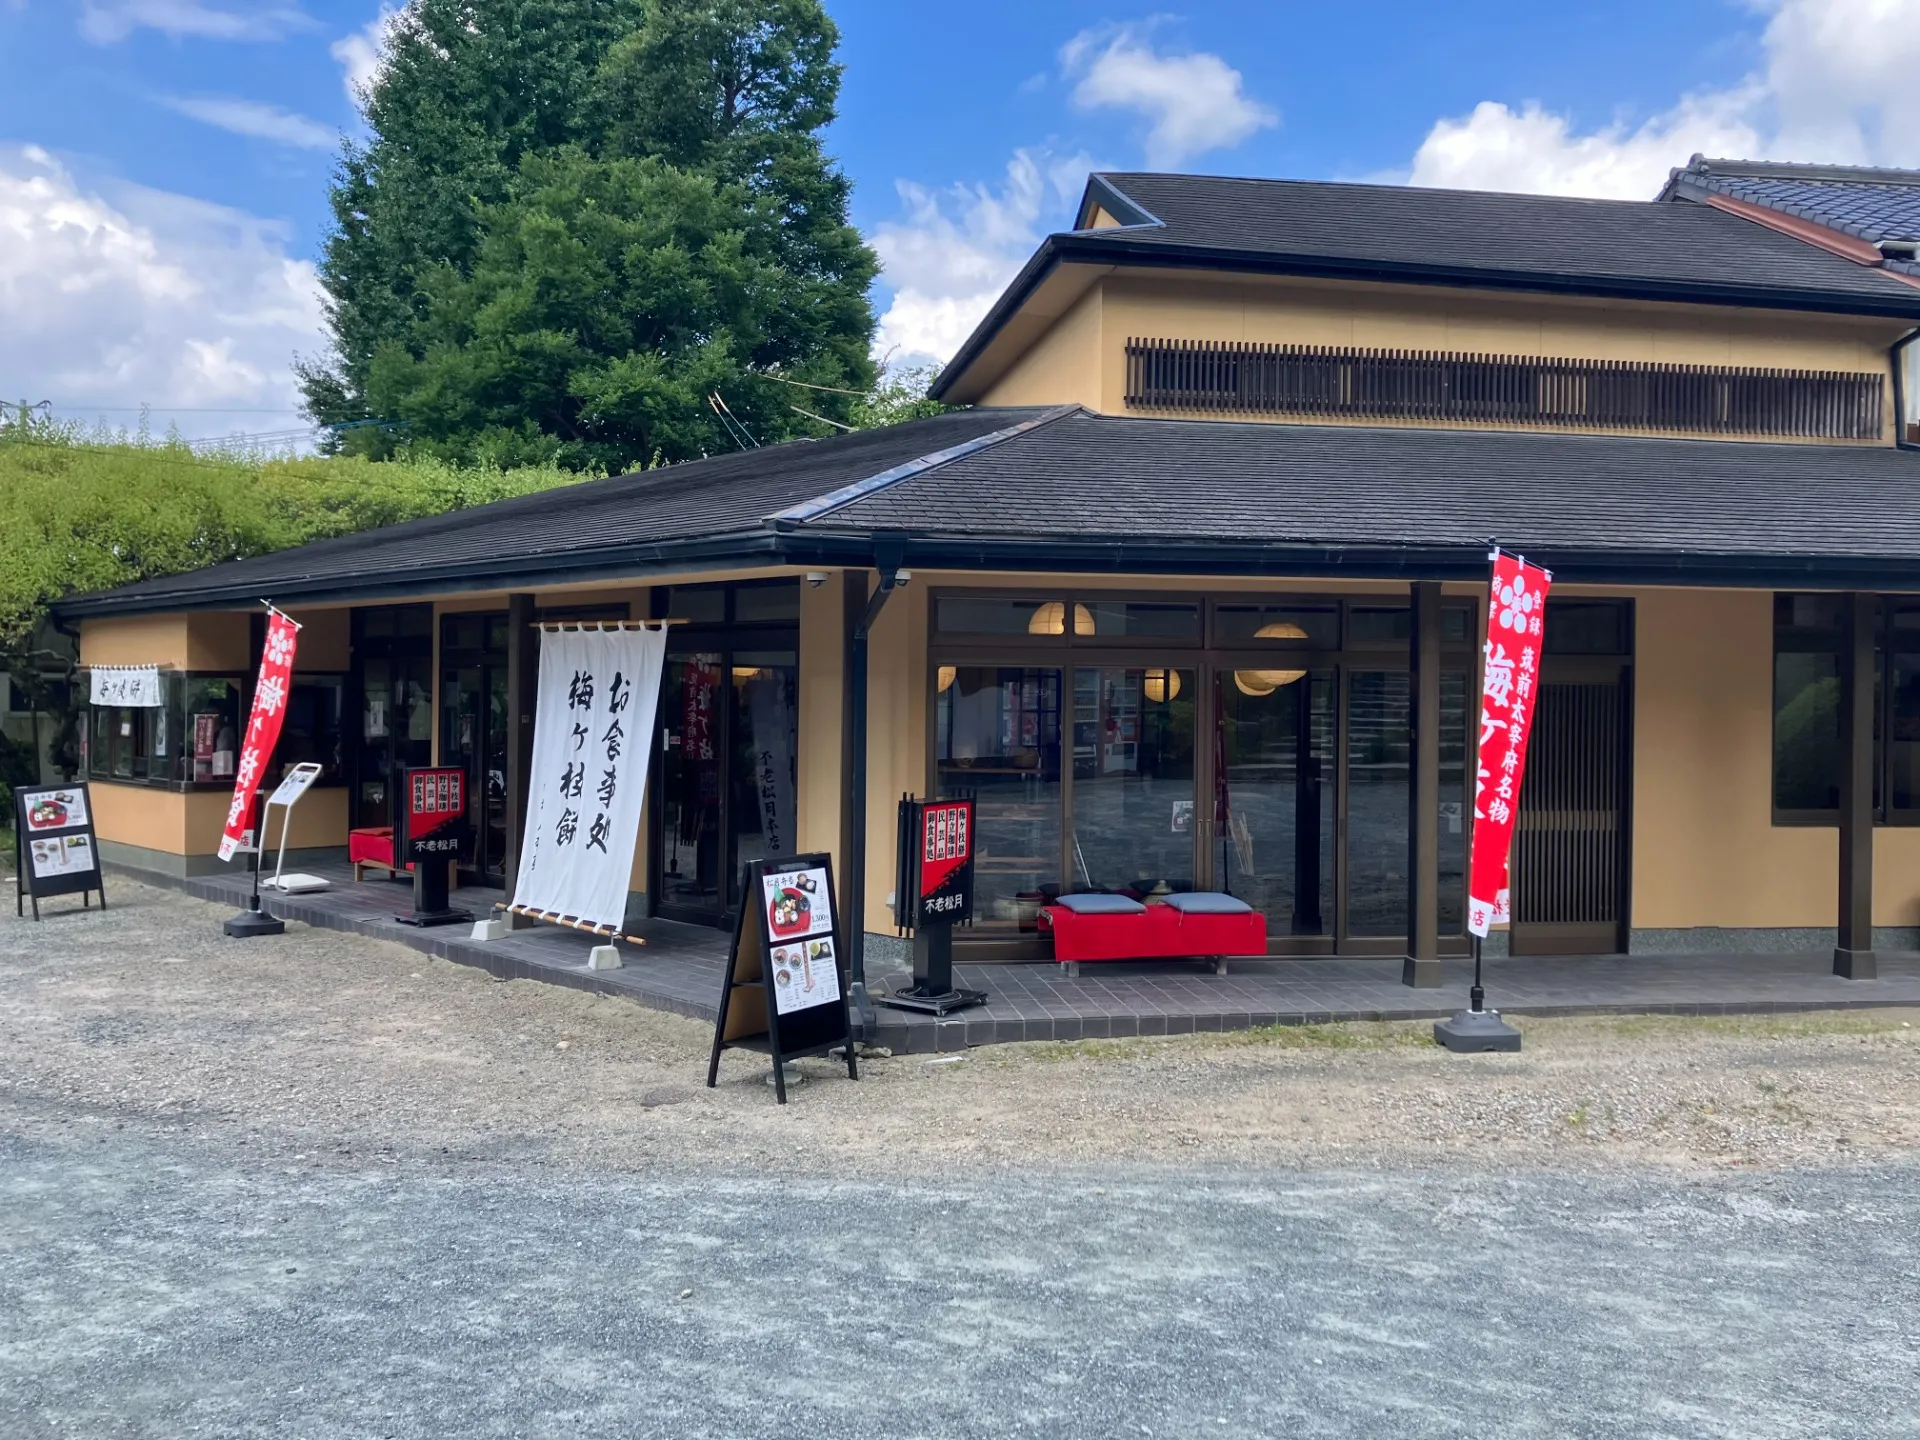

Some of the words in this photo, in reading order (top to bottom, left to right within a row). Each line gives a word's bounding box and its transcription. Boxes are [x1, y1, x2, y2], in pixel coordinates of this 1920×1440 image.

[1488, 646, 1534, 825] 筑前太宰府名物
[586, 671, 630, 854] お食事処
[426, 775, 435, 811] 民芸品
[439, 775, 447, 810] 野立珈琲
[759, 751, 780, 850] 不老松月本店
[414, 839, 458, 852] 不老松月
[937, 811, 946, 859] 民芸品
[948, 810, 957, 858] 野立珈琲
[925, 894, 963, 914] 不老松月
